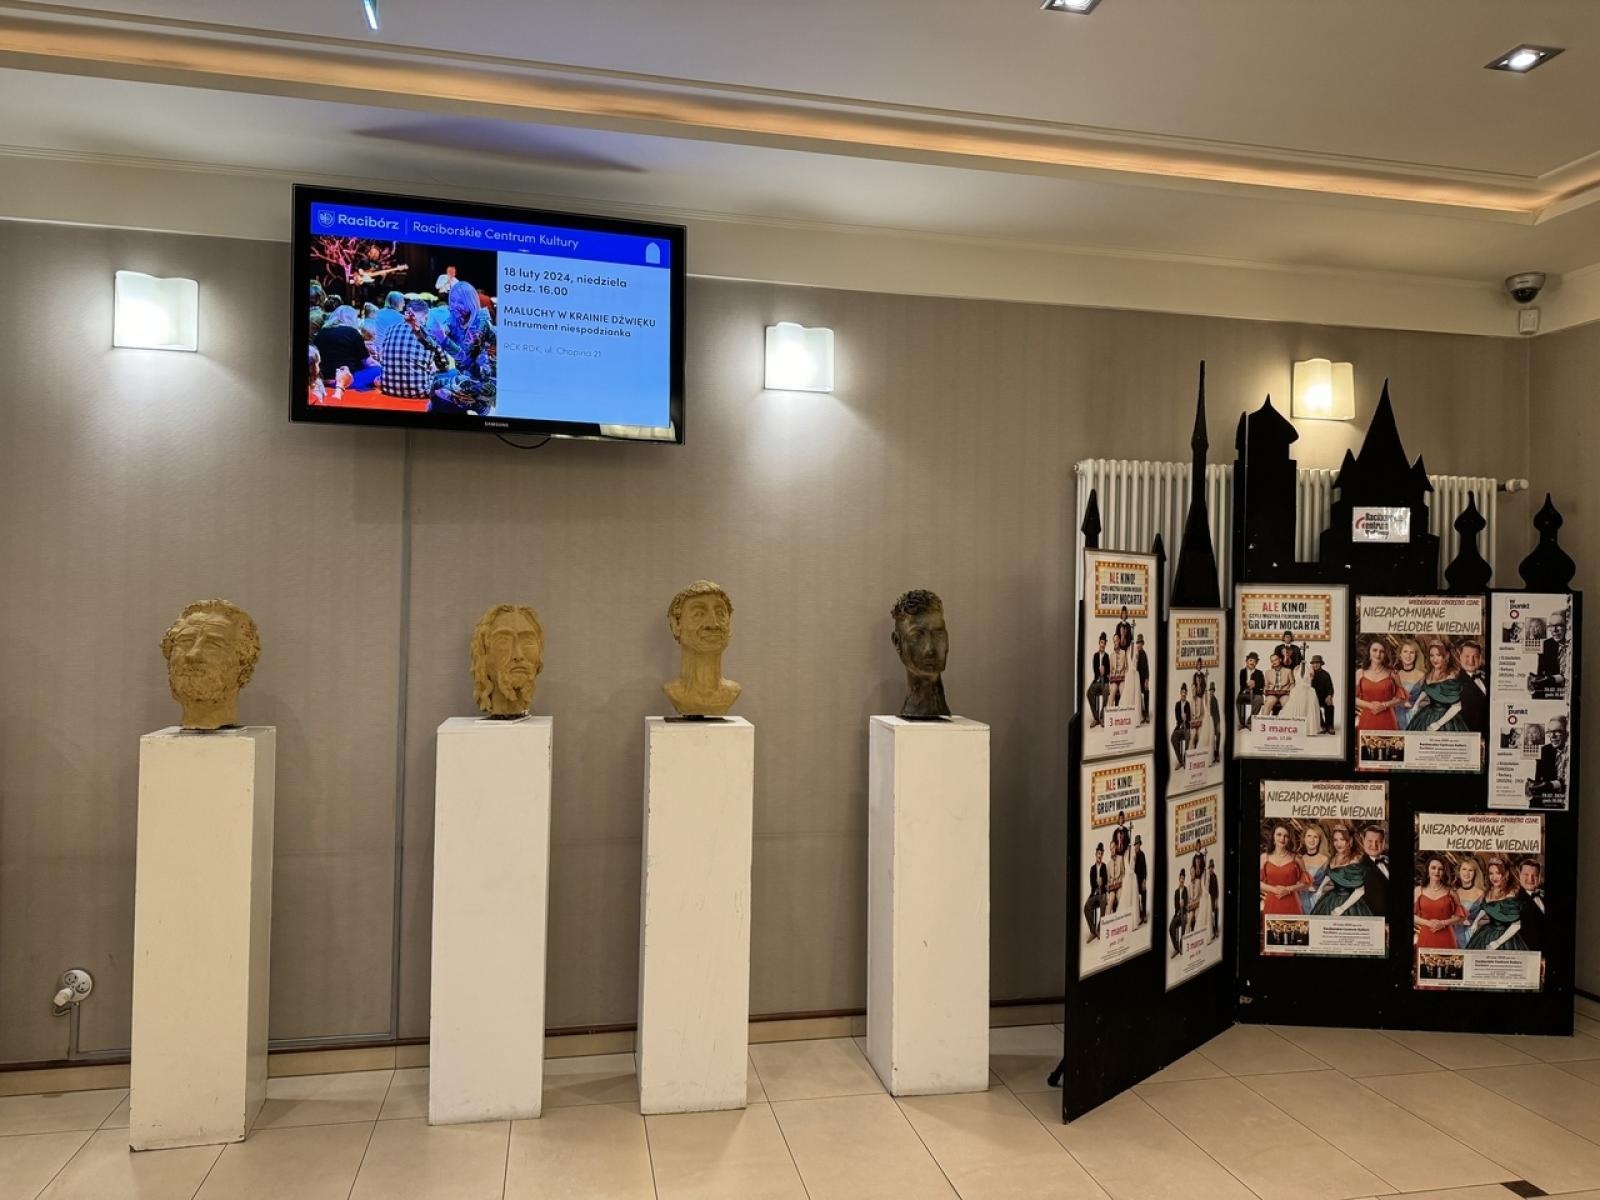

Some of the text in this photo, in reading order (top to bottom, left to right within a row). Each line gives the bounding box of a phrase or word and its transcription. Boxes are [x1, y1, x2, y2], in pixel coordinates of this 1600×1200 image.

[338, 213, 400, 231] Racibórz
[413, 221, 580, 250] Raciborskie Centrum Kultury
[504, 267, 628, 288] 18 luty 2024, niedziela
[504, 282, 568, 296] godz. 16.00
[504, 305, 656, 328] MALUCHY W KRAINIE DŹWIĘKU
[504, 318, 631, 338] Instrument niespodzianka
[556, 346, 592, 358] Chopina
[1109, 572, 1119, 584] ALE
[1262, 602, 1307, 613] ALE KINO!
[1363, 607, 1446, 618] NIEZAPOMNIANE
[1248, 620, 1320, 630] GRUPY MOCARTA
[1388, 620, 1480, 633] MELODIE WIEDNIA
[1114, 718, 1131, 726] marca
[1260, 724, 1298, 734] 3 marca
[1106, 780, 1116, 792] ALE
[1266, 791, 1350, 803] NIEZAPOMNIANE
[1292, 805, 1383, 817] MELODIE WIEDNIA
[1421, 824, 1505, 836] NIEZAPOMNIANE
[1446, 838, 1539, 851] MELODIE WIEDNIA
